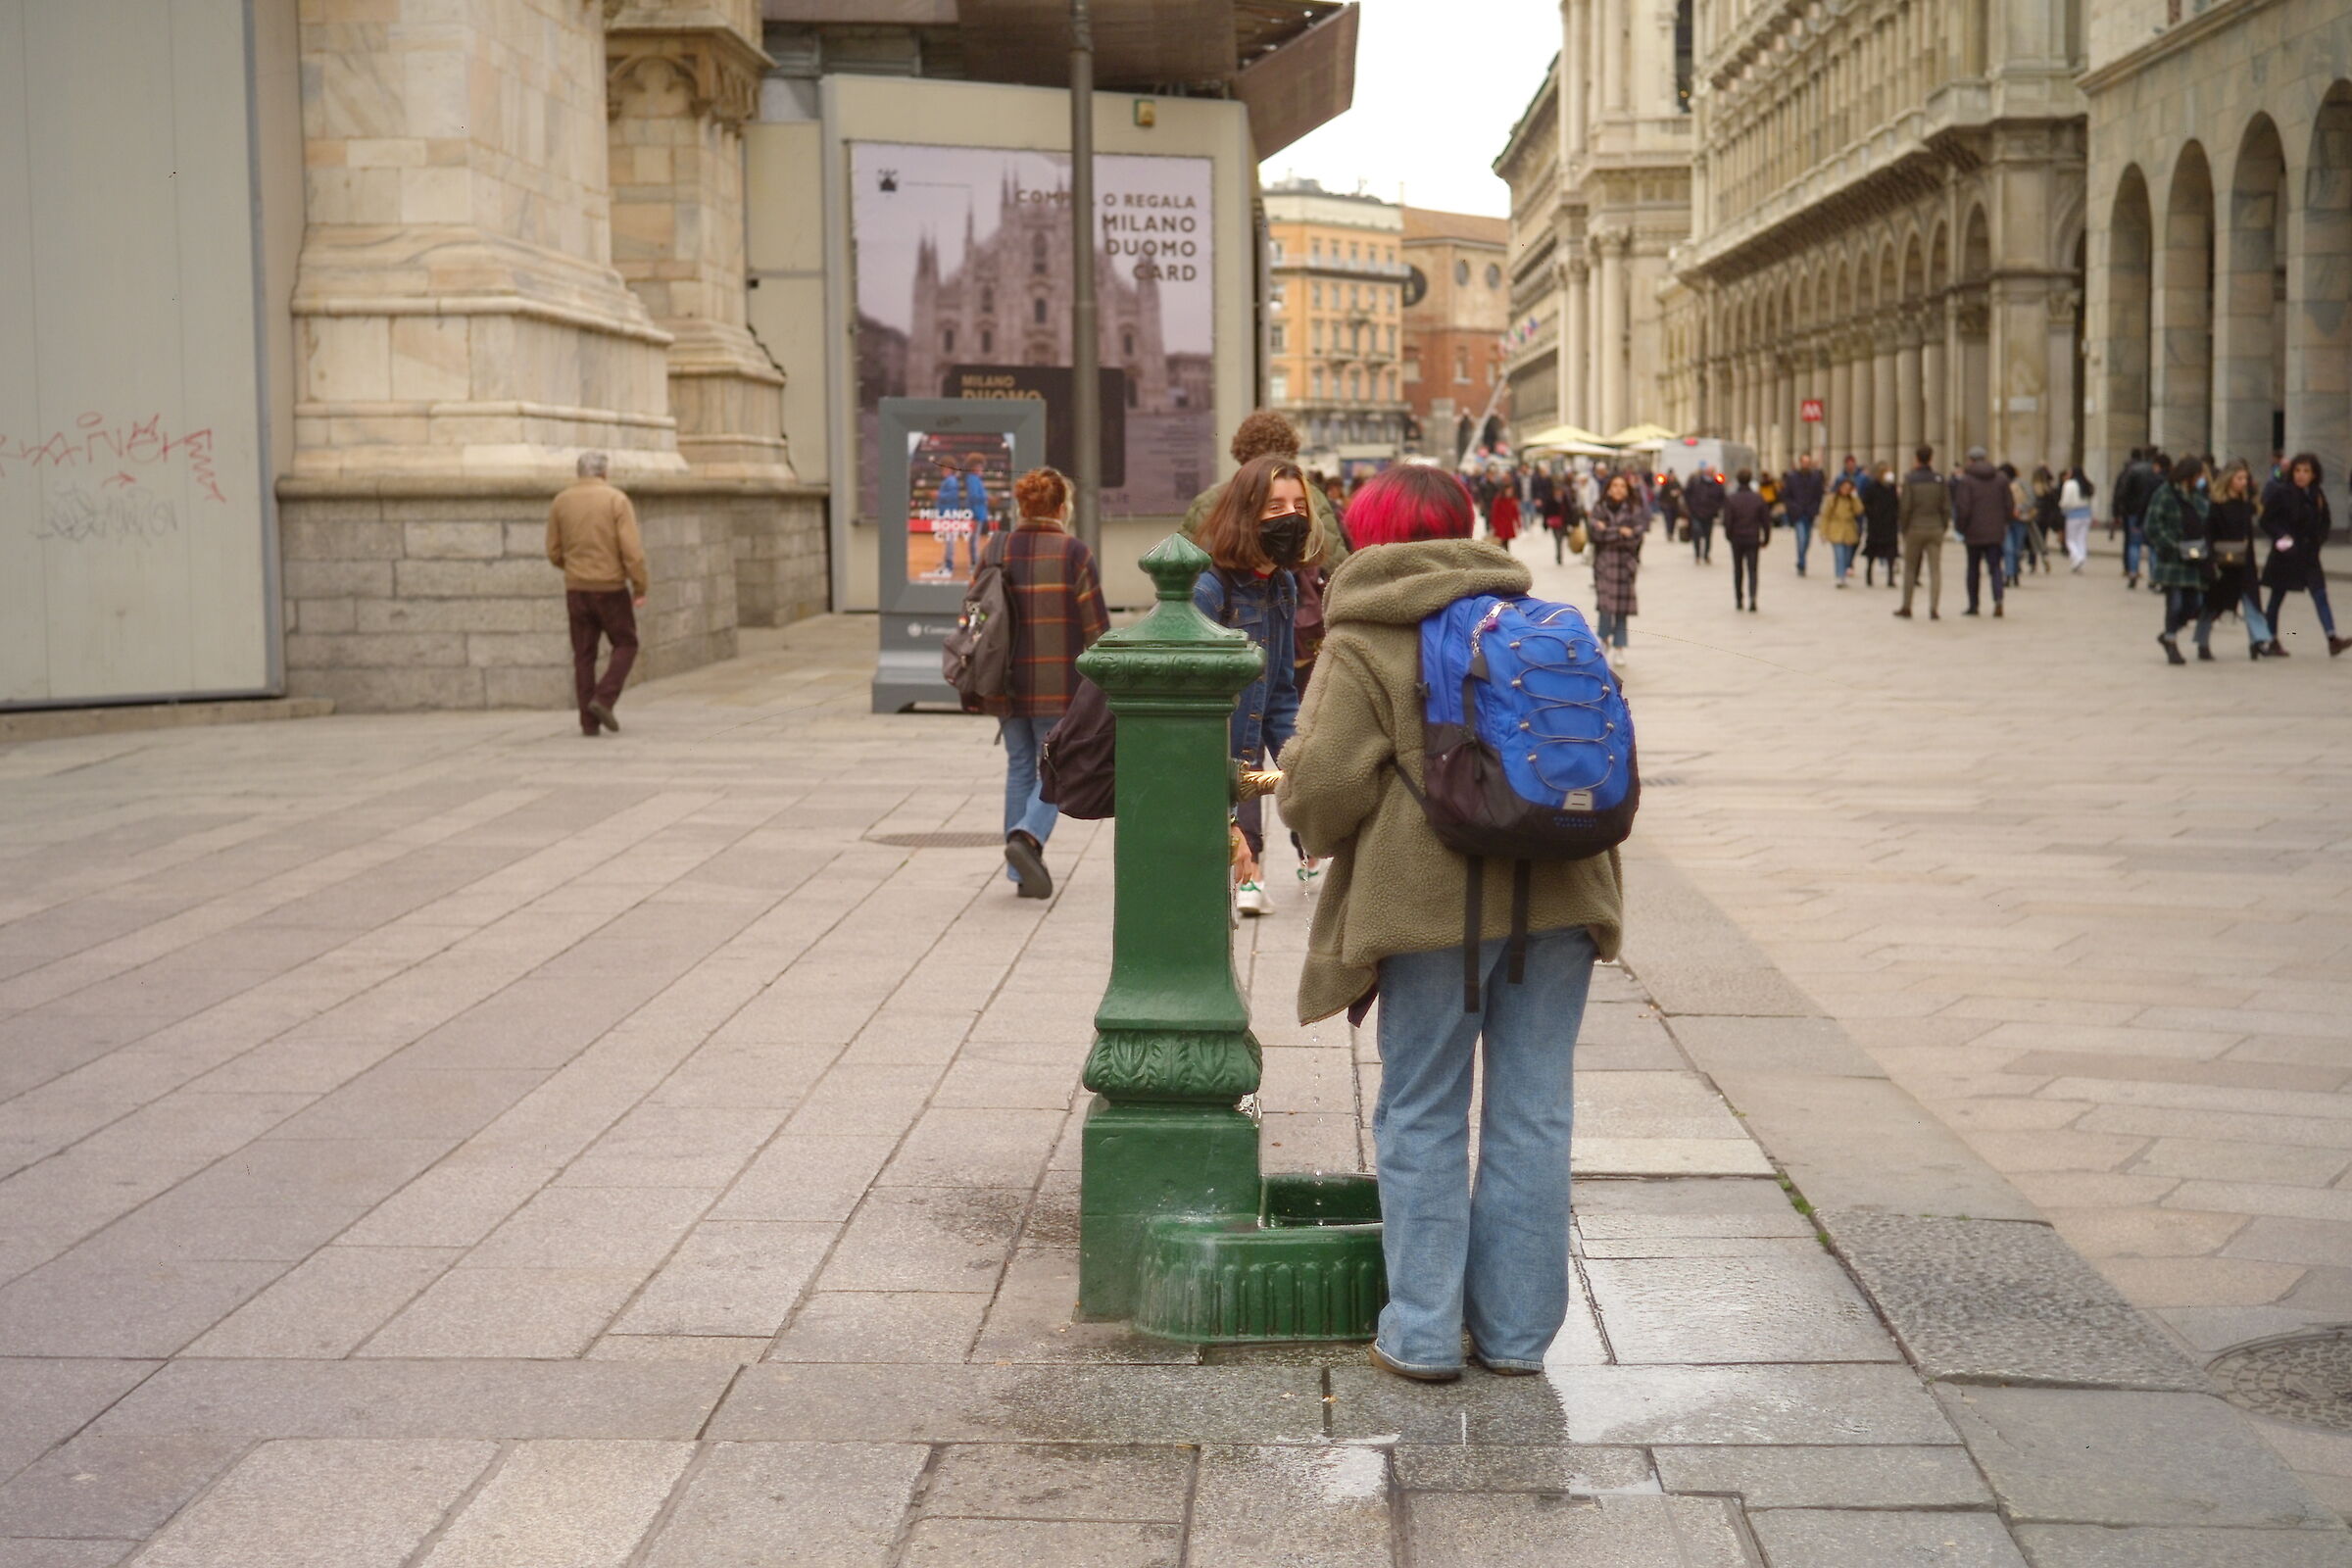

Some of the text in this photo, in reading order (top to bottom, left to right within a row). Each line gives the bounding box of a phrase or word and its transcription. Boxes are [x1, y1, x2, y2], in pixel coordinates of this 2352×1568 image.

[1103, 193, 1117, 207] O
[1124, 194, 1197, 209] REGALA
[1102, 215, 1197, 233] MILANO
[1105, 239, 1197, 258] DUOMO
[1133, 264, 1197, 281] CARD
[961, 374, 1015, 388] MILANO
[919, 509, 974, 520] MILANO
